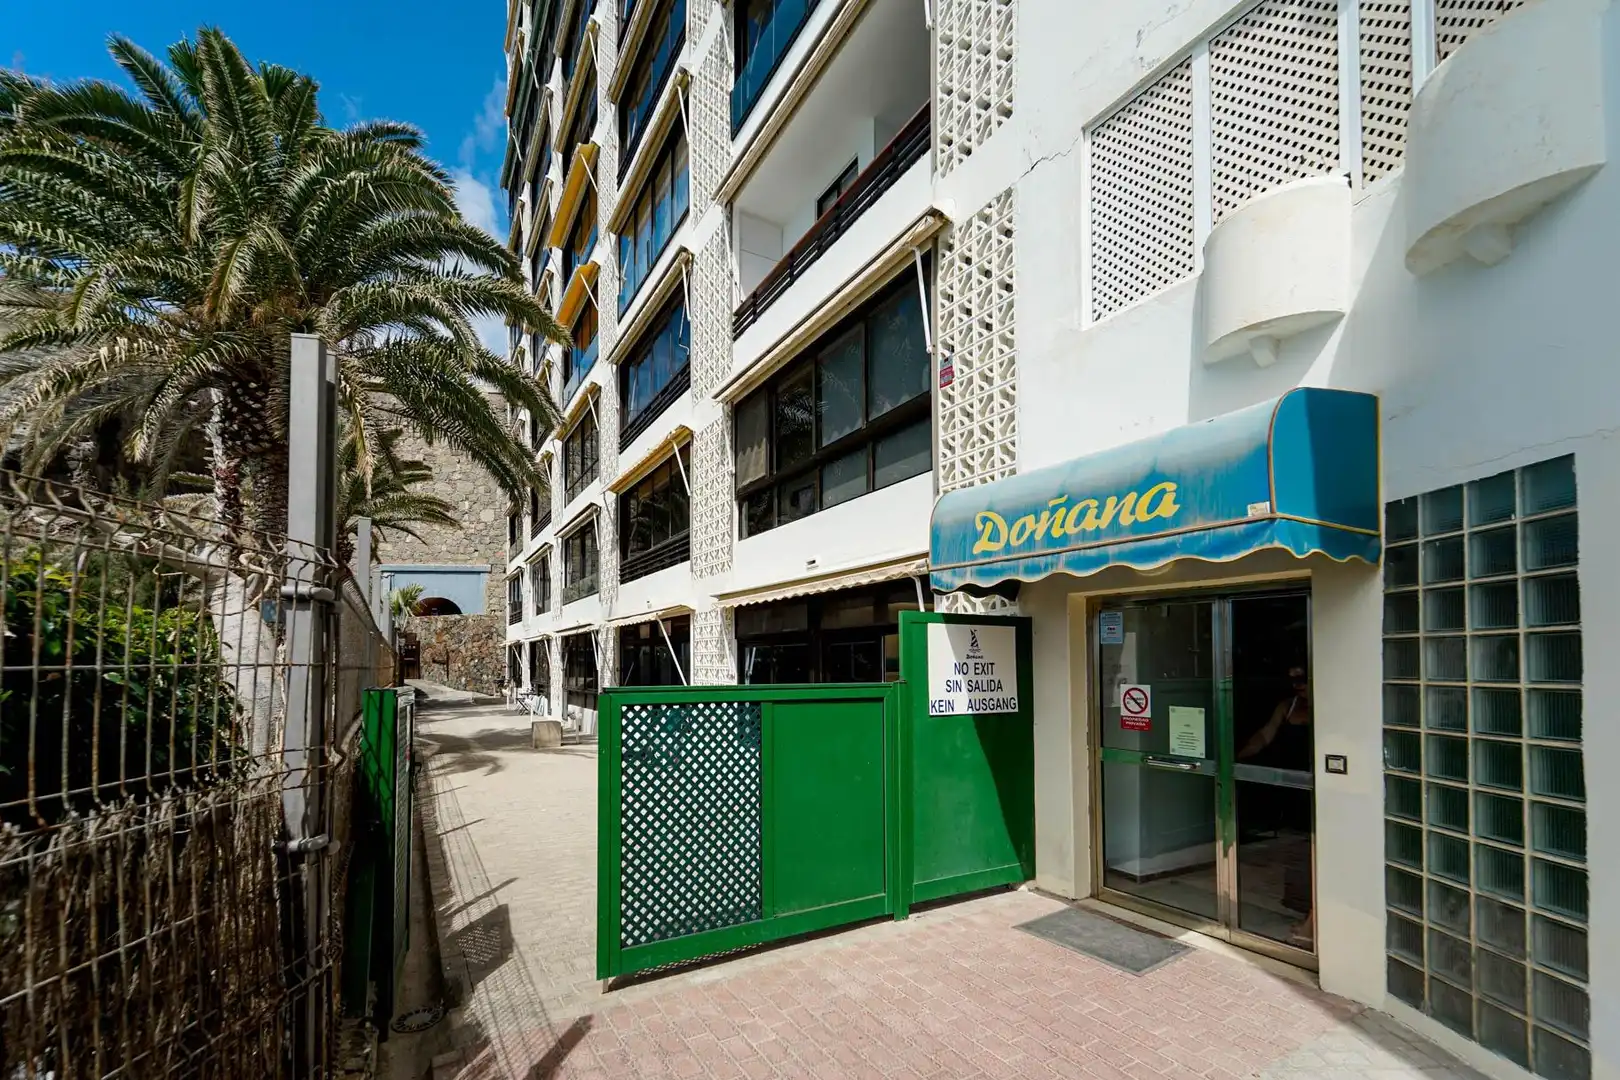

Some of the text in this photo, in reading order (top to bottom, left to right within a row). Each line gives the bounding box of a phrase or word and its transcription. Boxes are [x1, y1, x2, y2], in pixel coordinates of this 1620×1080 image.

[973, 482, 1180, 554] Doñana
[954, 662, 995, 676] NO EXIT
[945, 680, 1003, 693] SIN SALIDA
[930, 697, 1017, 713] KEIN AUSGANG
